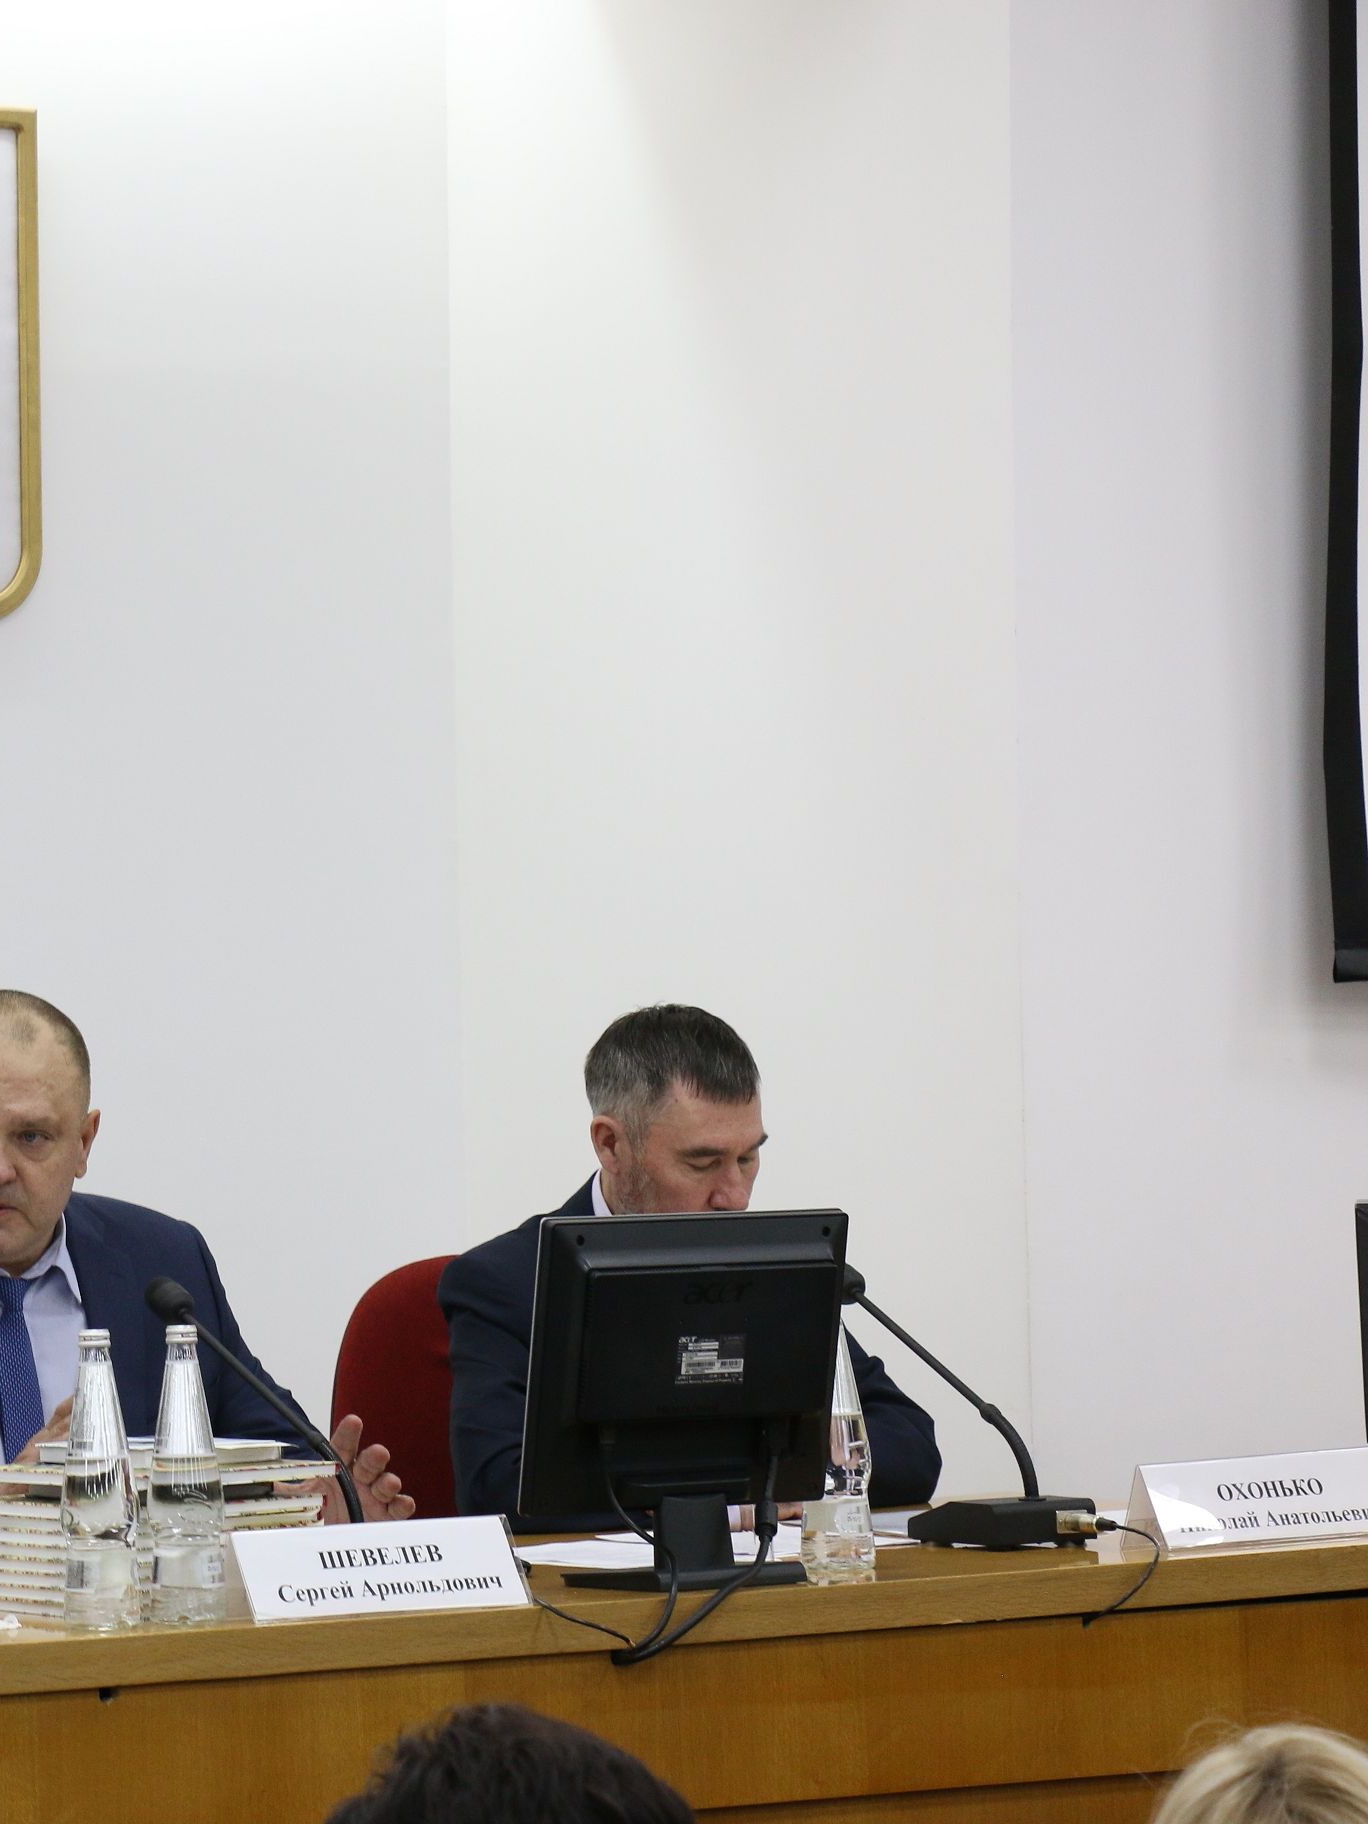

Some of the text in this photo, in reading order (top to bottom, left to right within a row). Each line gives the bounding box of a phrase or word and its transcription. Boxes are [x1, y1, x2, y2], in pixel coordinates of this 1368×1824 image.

[1216, 1477, 1324, 1502] ОХОНЬКО
[1180, 1511, 1261, 1534] олай
[318, 1543, 444, 1570] ШЕВЕЛЕВ
[278, 1574, 503, 1606] Сергей Арнольдович
